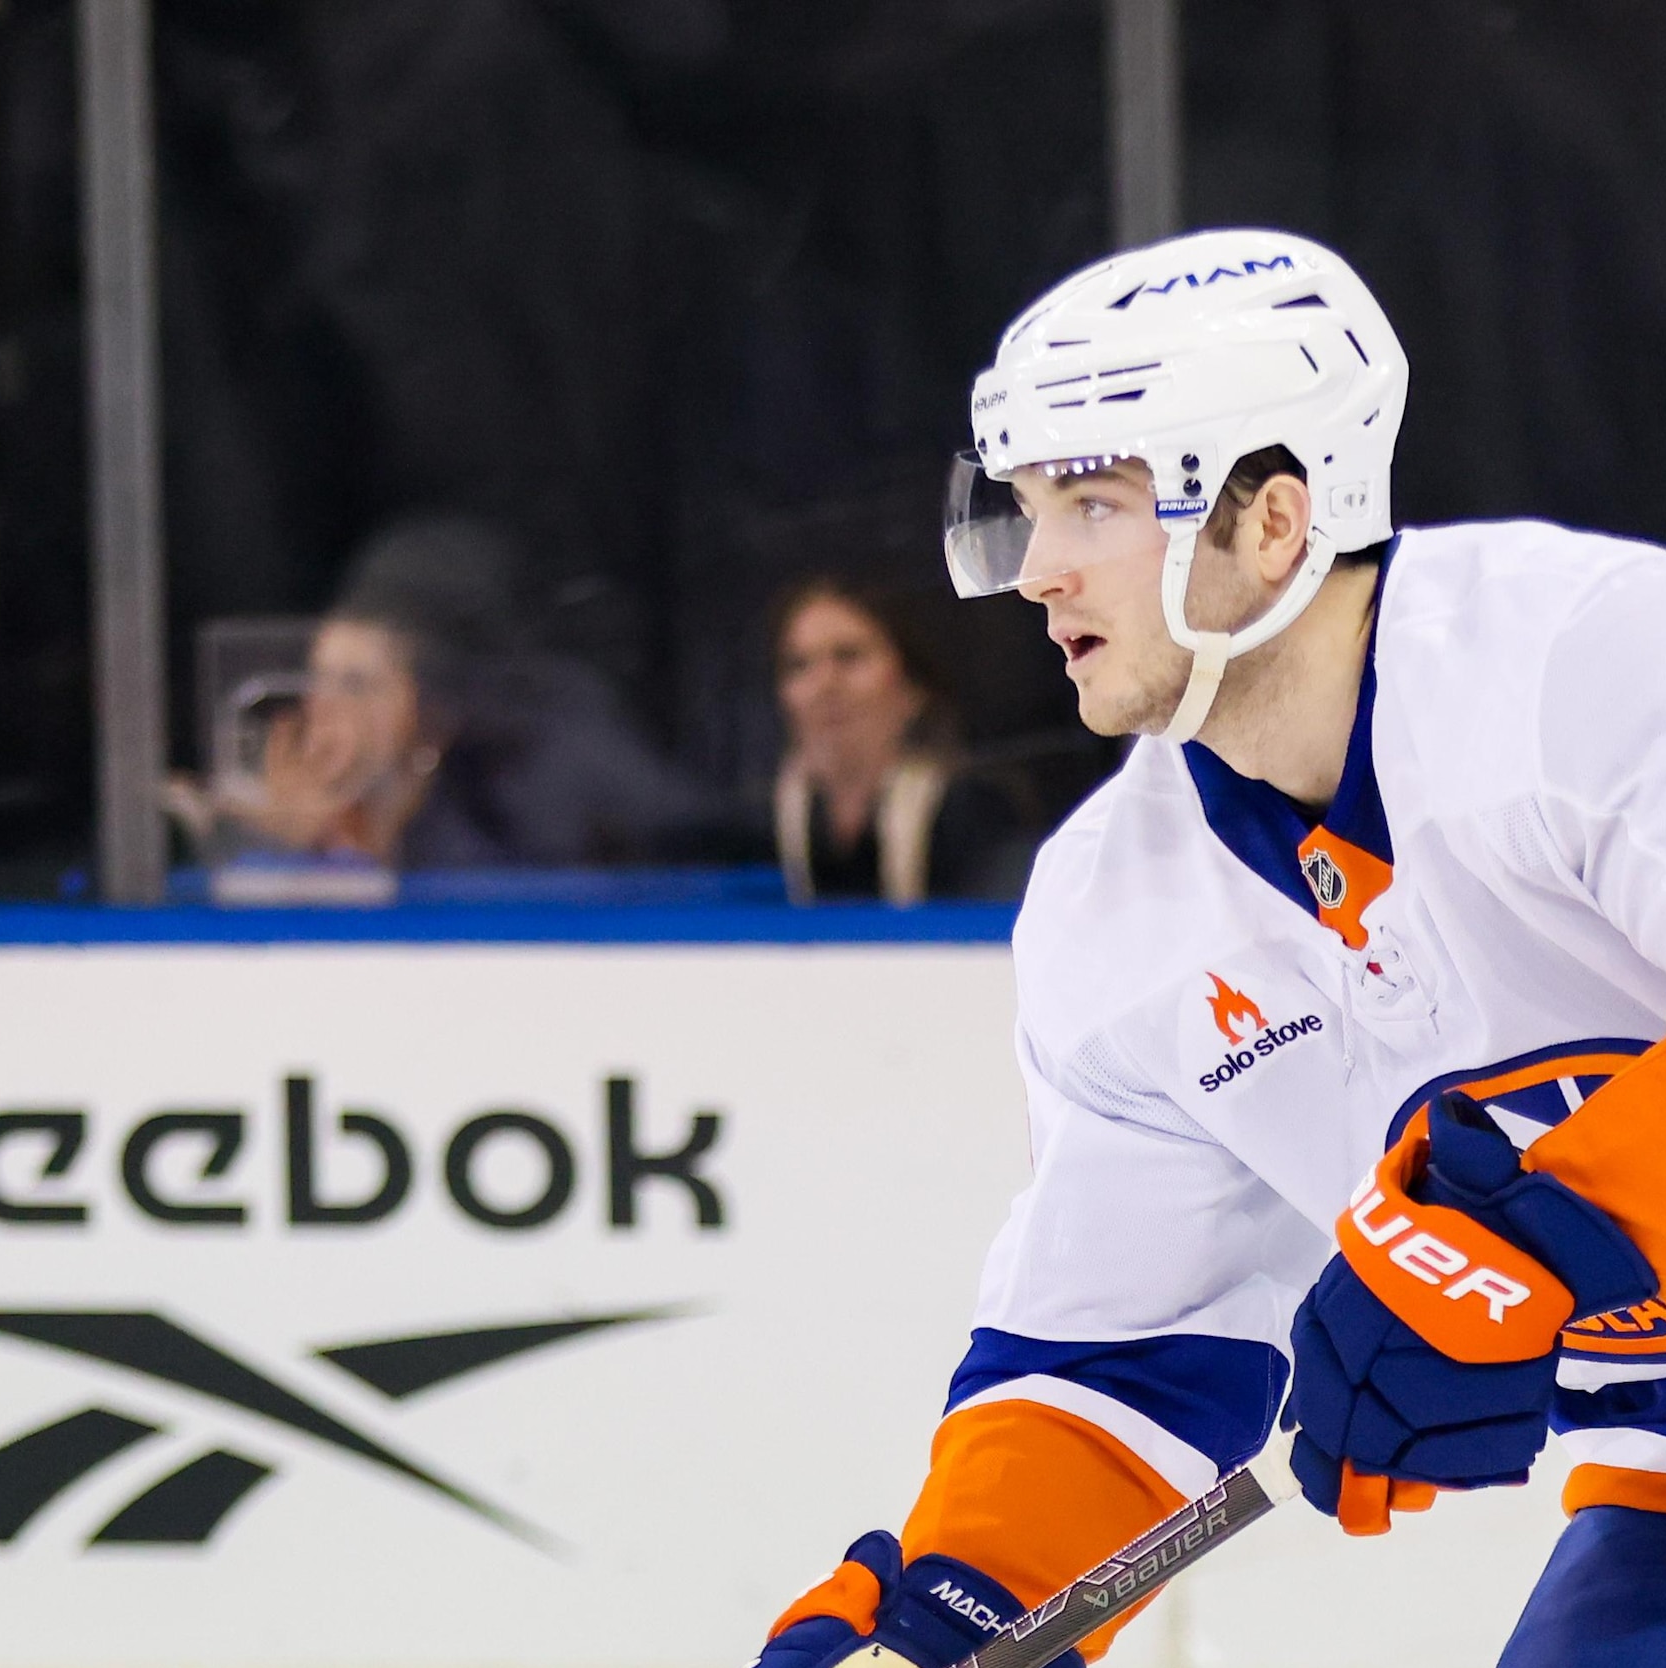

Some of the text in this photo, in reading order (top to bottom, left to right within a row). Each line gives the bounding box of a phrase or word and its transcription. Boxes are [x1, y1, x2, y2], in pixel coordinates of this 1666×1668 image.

[1141, 256, 1294, 294] VIAM
[1158, 501, 1205, 511] BAUER
[1199, 1014, 1323, 1092] solo stove
[1113, 1507, 1230, 1599] BAUER
[929, 1580, 1011, 1637] MACH
